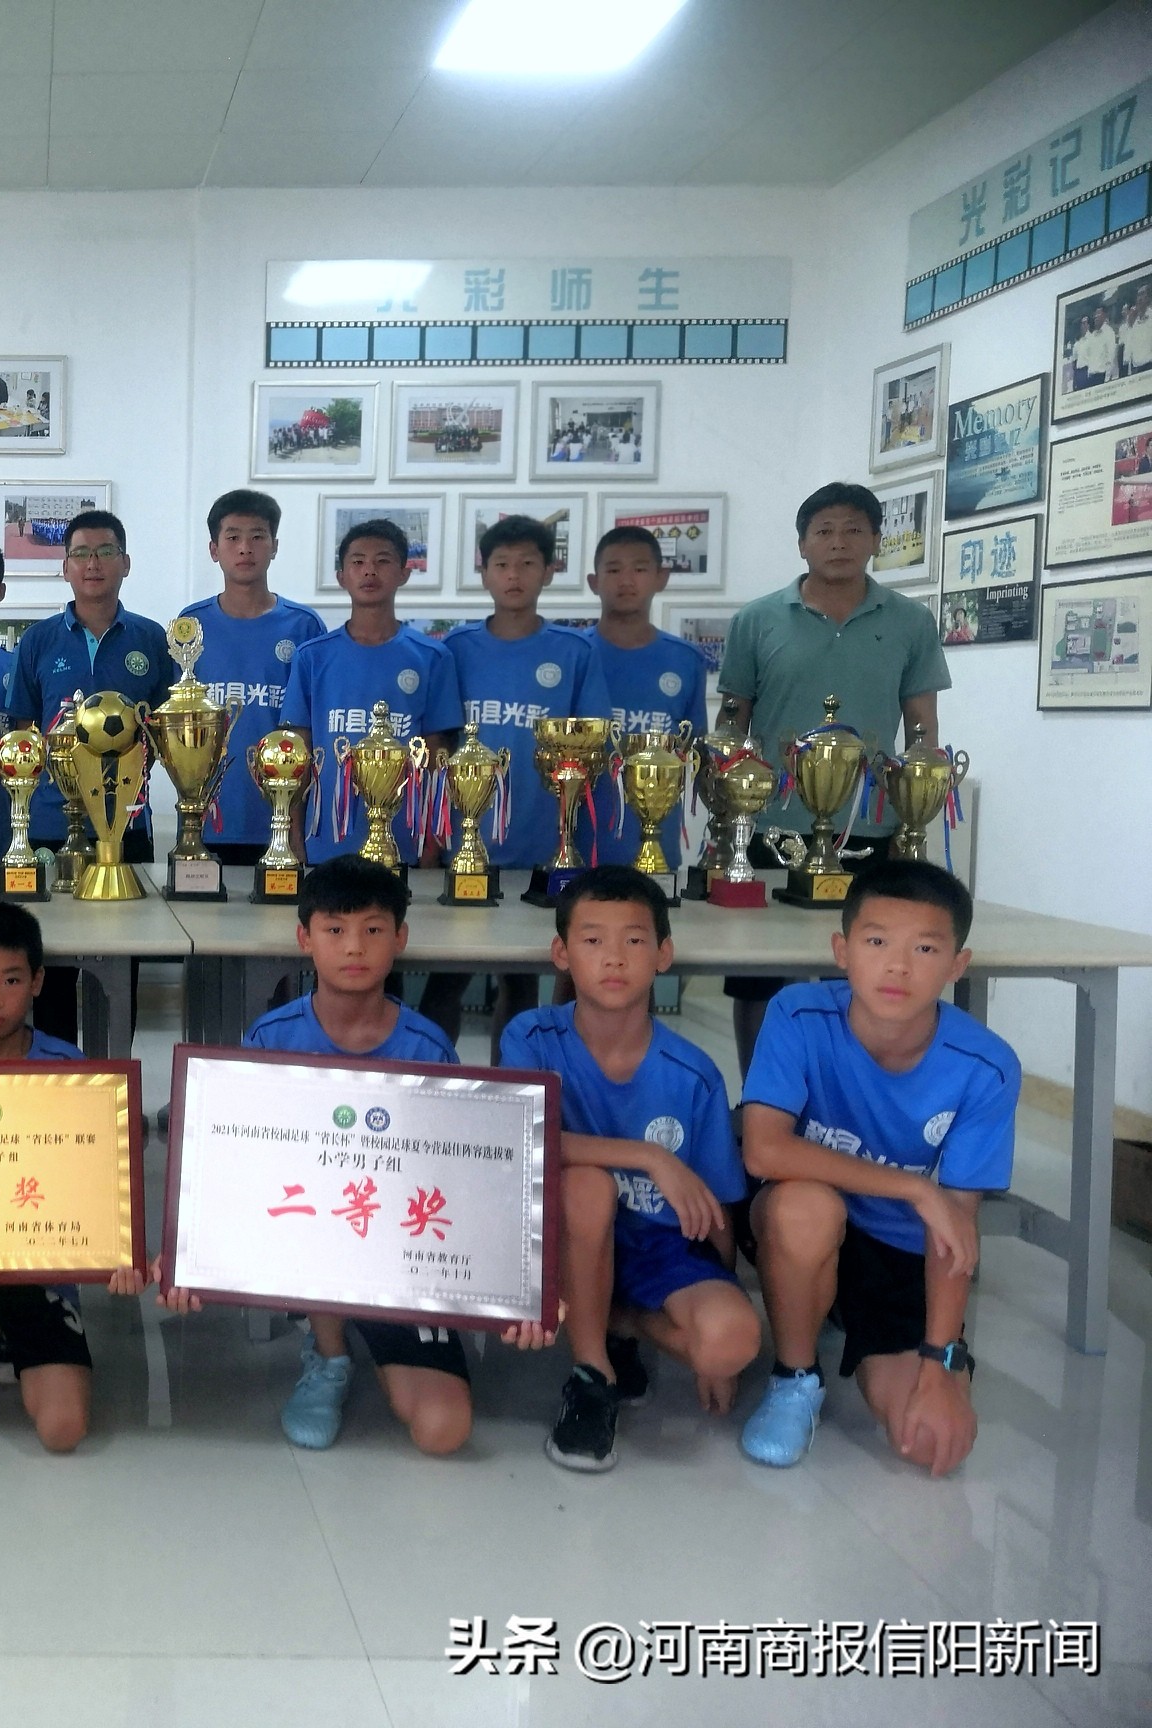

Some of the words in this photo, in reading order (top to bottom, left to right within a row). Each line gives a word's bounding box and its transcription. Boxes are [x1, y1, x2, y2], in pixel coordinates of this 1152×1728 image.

[959, 95, 1138, 247] 光彩记忆
[953, 396, 1038, 441] Memory
[960, 531, 1018, 584] 印迹
[986, 584, 1029, 603] Imprinting
[317, 1150, 403, 1173] 小学男子组
[267, 1175, 453, 1241] 二等奖
[5, 1221, 82, 1233] 河南省体育局
[403, 1249, 472, 1266] 河南省教育厅
